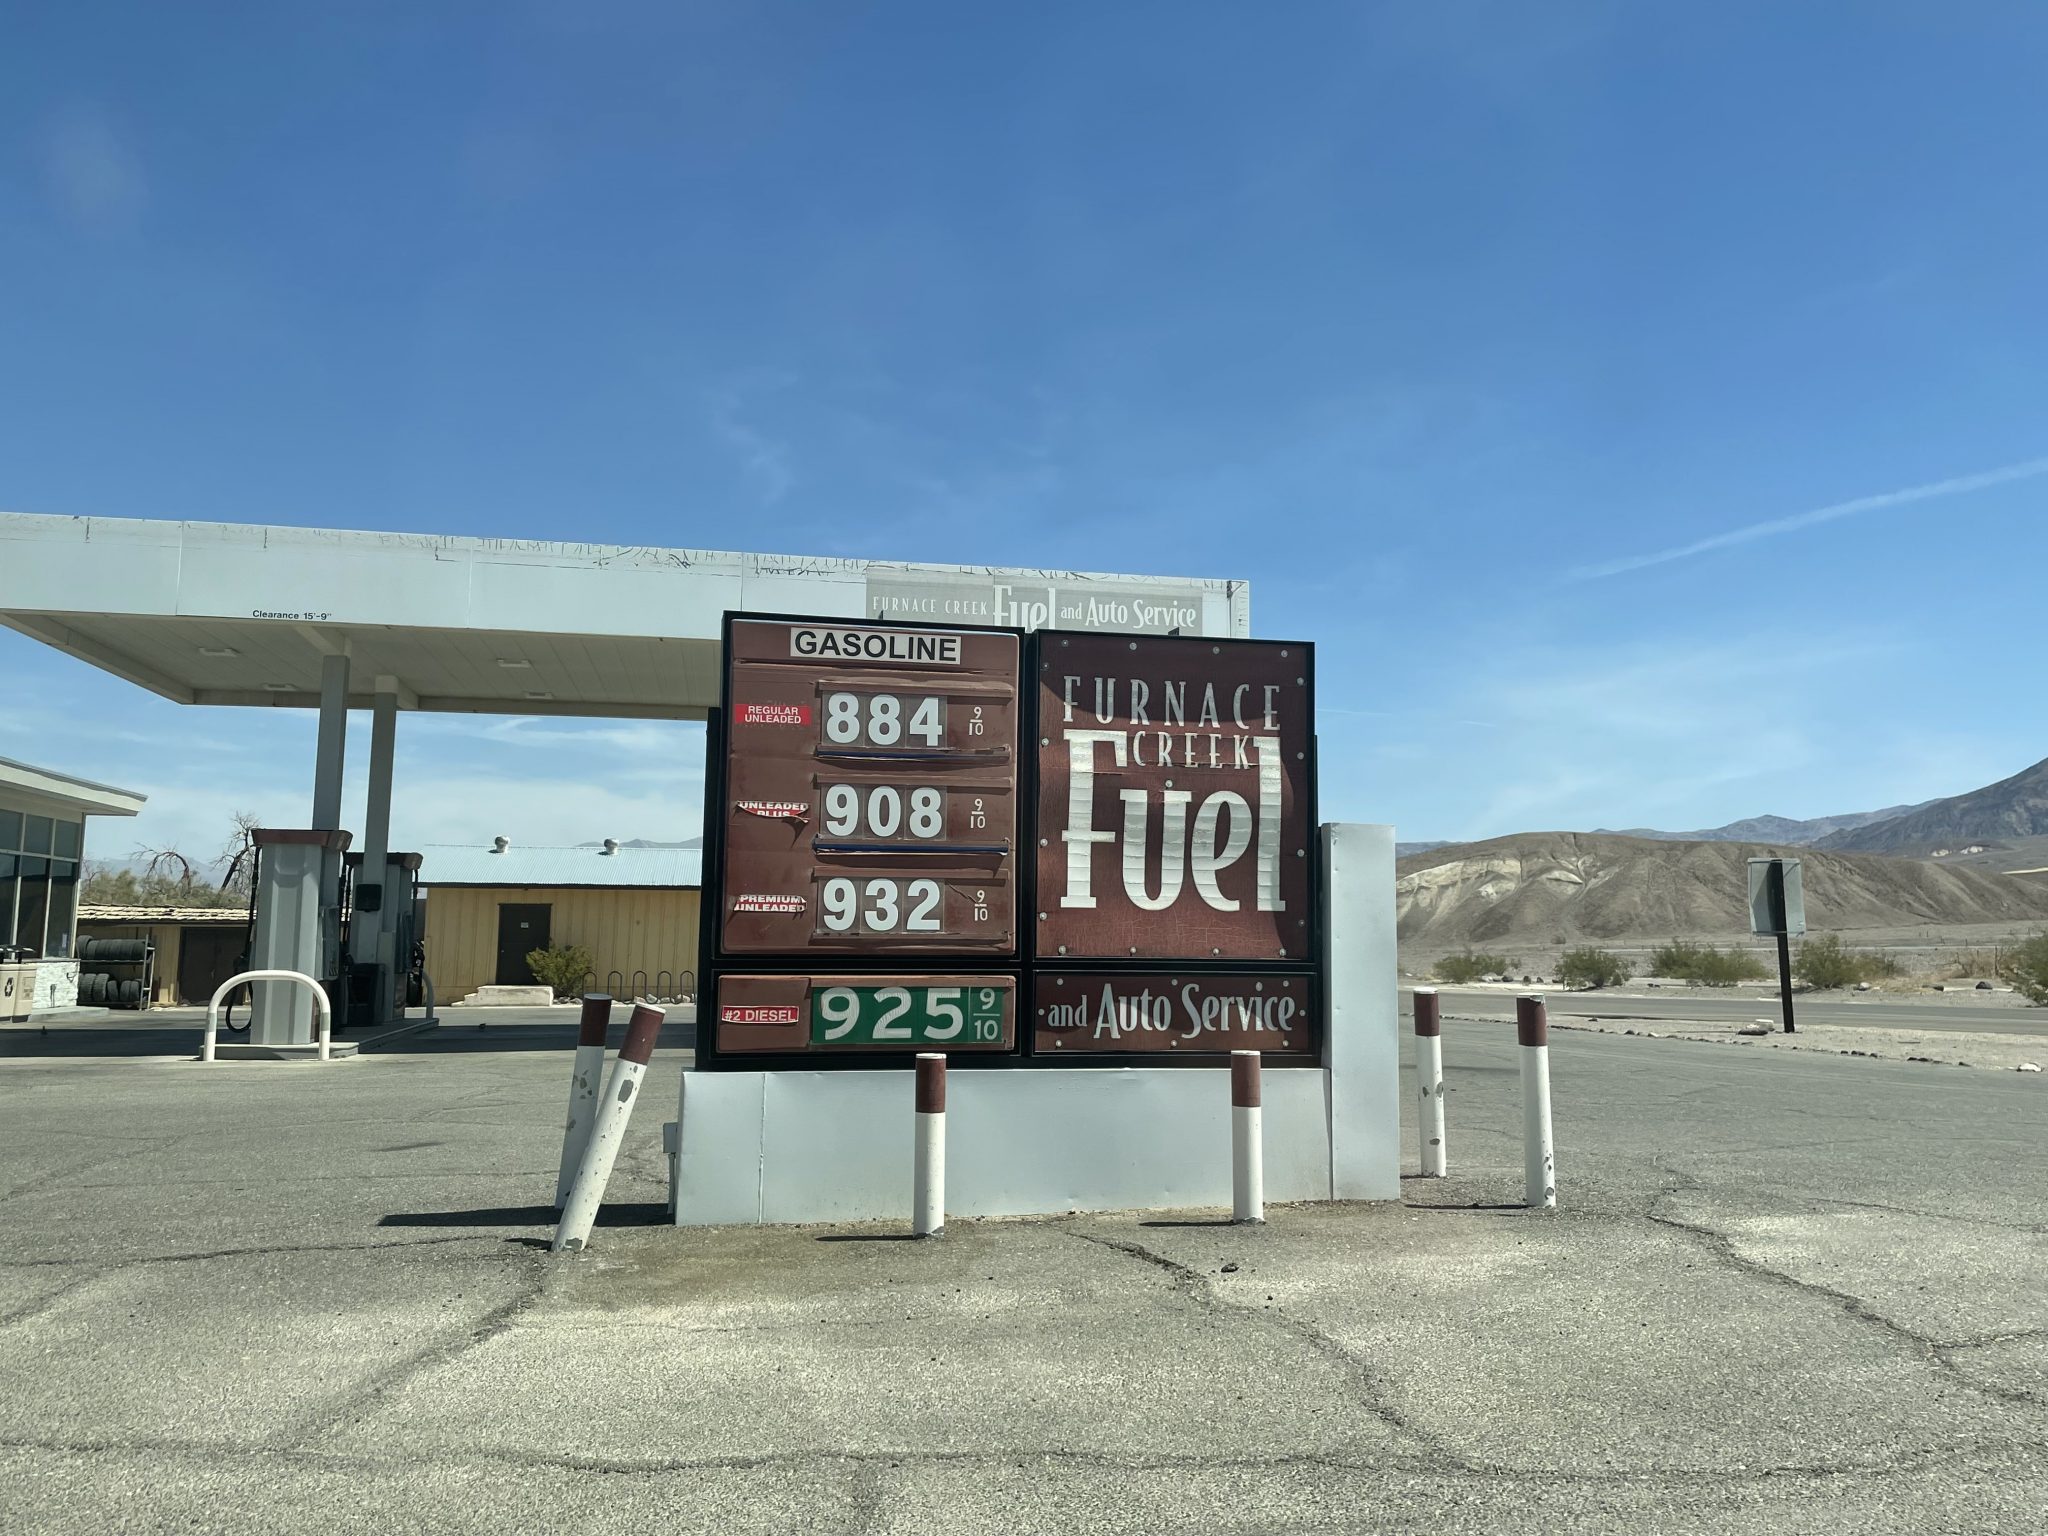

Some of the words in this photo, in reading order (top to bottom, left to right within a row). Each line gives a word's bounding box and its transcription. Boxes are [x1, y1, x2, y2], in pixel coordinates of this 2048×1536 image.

[252, 610, 299, 619] Clearance
[873, 596, 936, 613] FURNACE
[945, 600, 988, 615] CREEK
[993, 585, 1056, 633] Fuel
[1060, 603, 1082, 620] and
[1085, 597, 1128, 627] Auto
[1132, 600, 1196, 629] Service
[794, 630, 957, 662] GASOLINE
[744, 714, 802, 724] UNLEADED
[748, 705, 799, 716] REGULAR
[1063, 675, 1281, 731] FURNACE
[826, 692, 943, 747] 884
[1132, 730, 1250, 770] CREEK
[740, 801, 809, 811] UNLEADED
[825, 783, 943, 838] 908
[1060, 728, 1286, 912] Fuel
[739, 895, 802, 904] PREMIUM
[823, 877, 941, 931] 932
[820, 986, 964, 1040] 925
[979, 987, 995, 1010] 9
[1047, 994, 1088, 1027] and
[1093, 983, 1172, 1039] Auto
[1181, 983, 1296, 1039] Service
[725, 1010, 741, 1021] #2
[745, 1010, 796, 1021] DIESEL
[974, 1019, 999, 1040] 10
